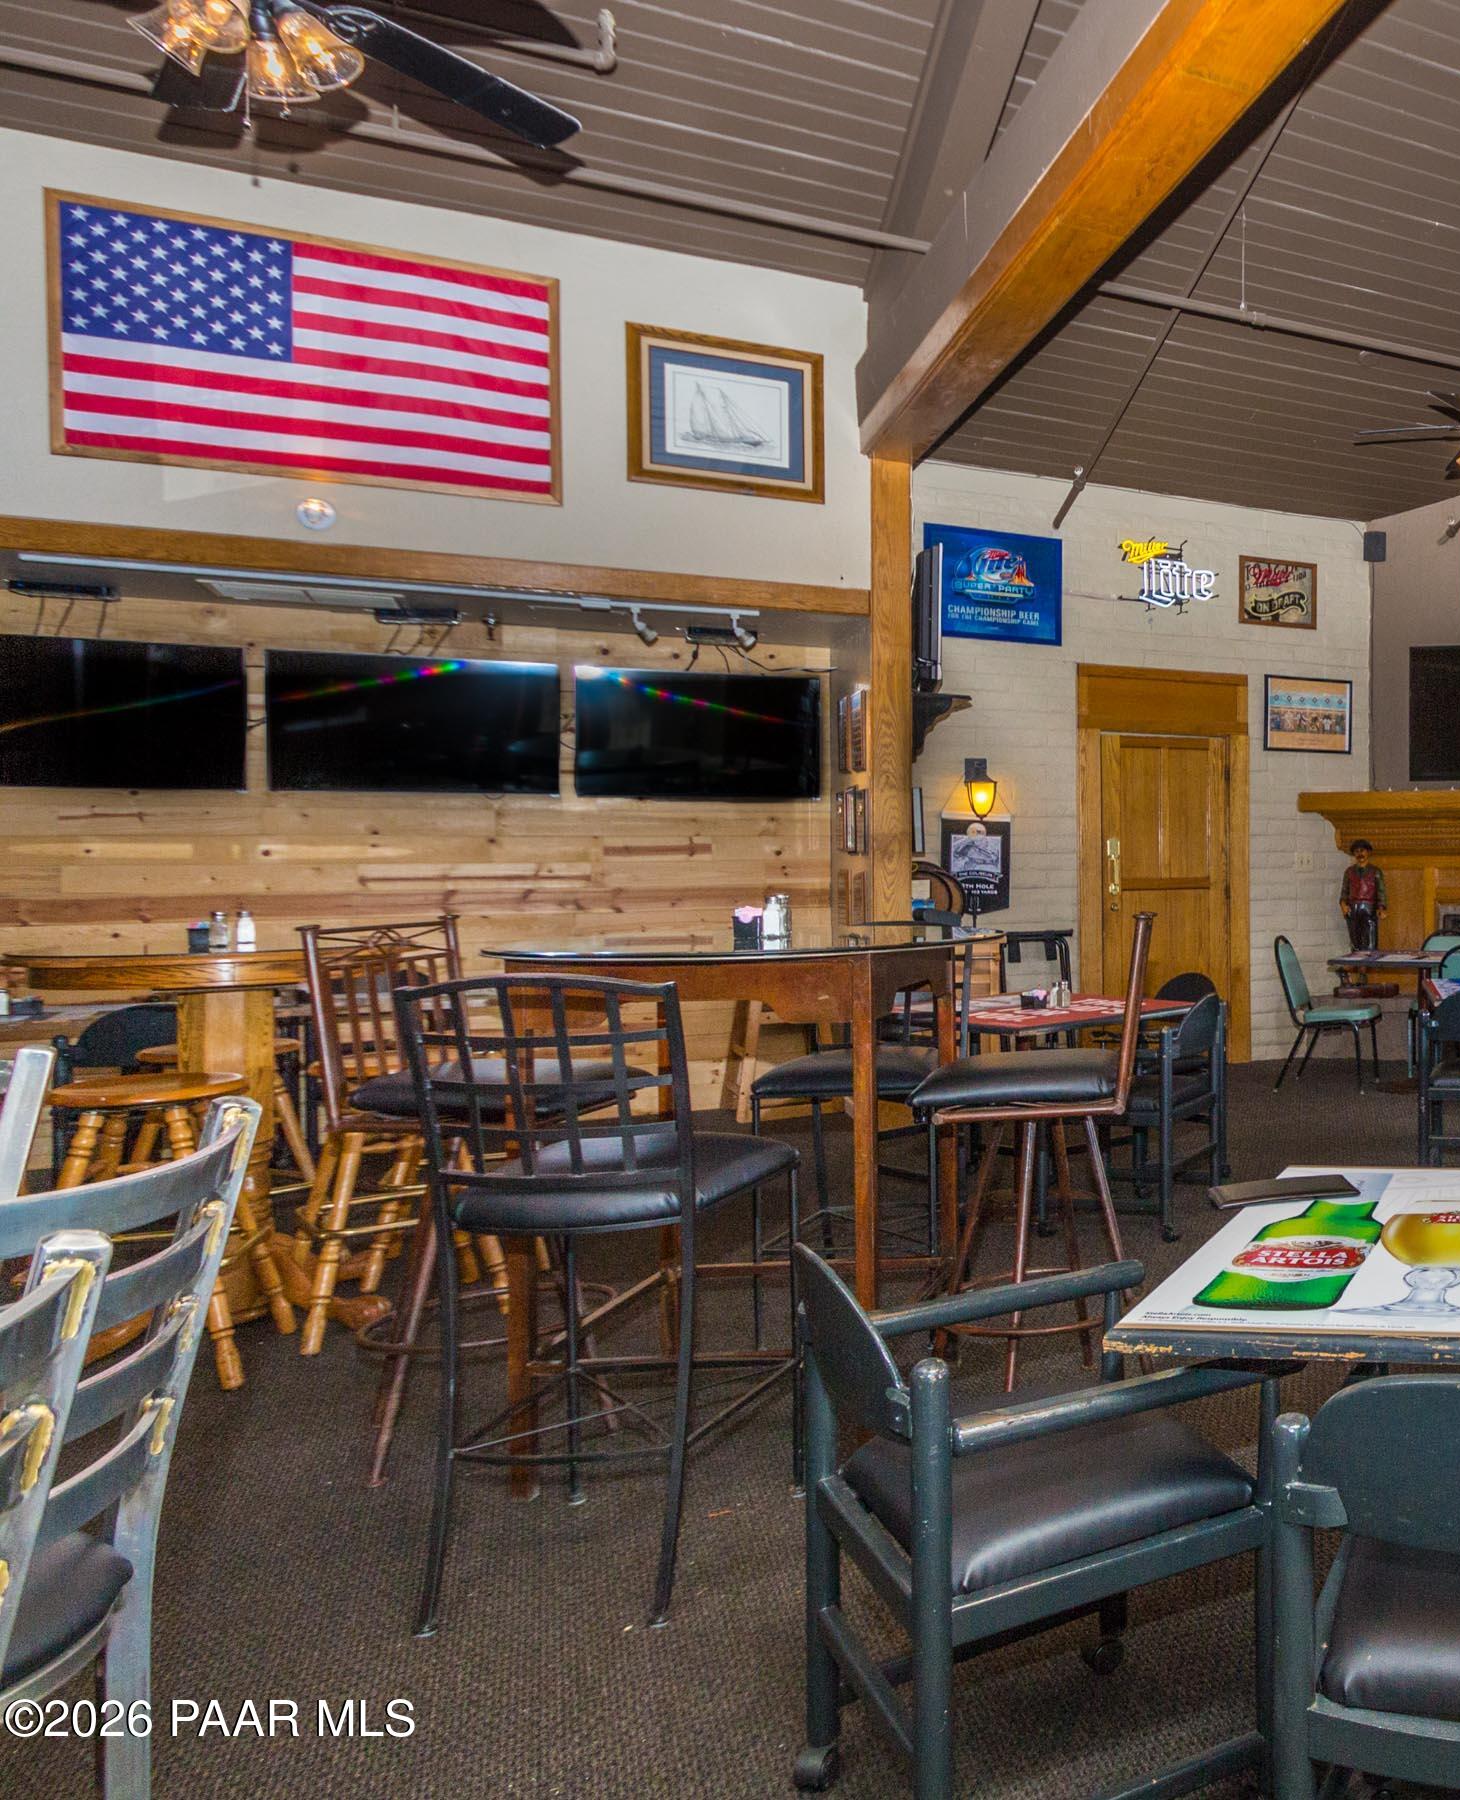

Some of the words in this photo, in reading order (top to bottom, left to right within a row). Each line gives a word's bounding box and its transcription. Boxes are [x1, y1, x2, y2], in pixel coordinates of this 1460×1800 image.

[1121, 539, 1168, 563] Miller
[1139, 558, 1215, 608] Lite
[948, 604, 1016, 618] CHAMPIONSHIP
[1019, 611, 1039, 620] BEER
[1256, 602, 1270, 613] ON
[1258, 1249, 1348, 1258] STELLA
[1250, 1257, 1346, 1265] ARTOIS
